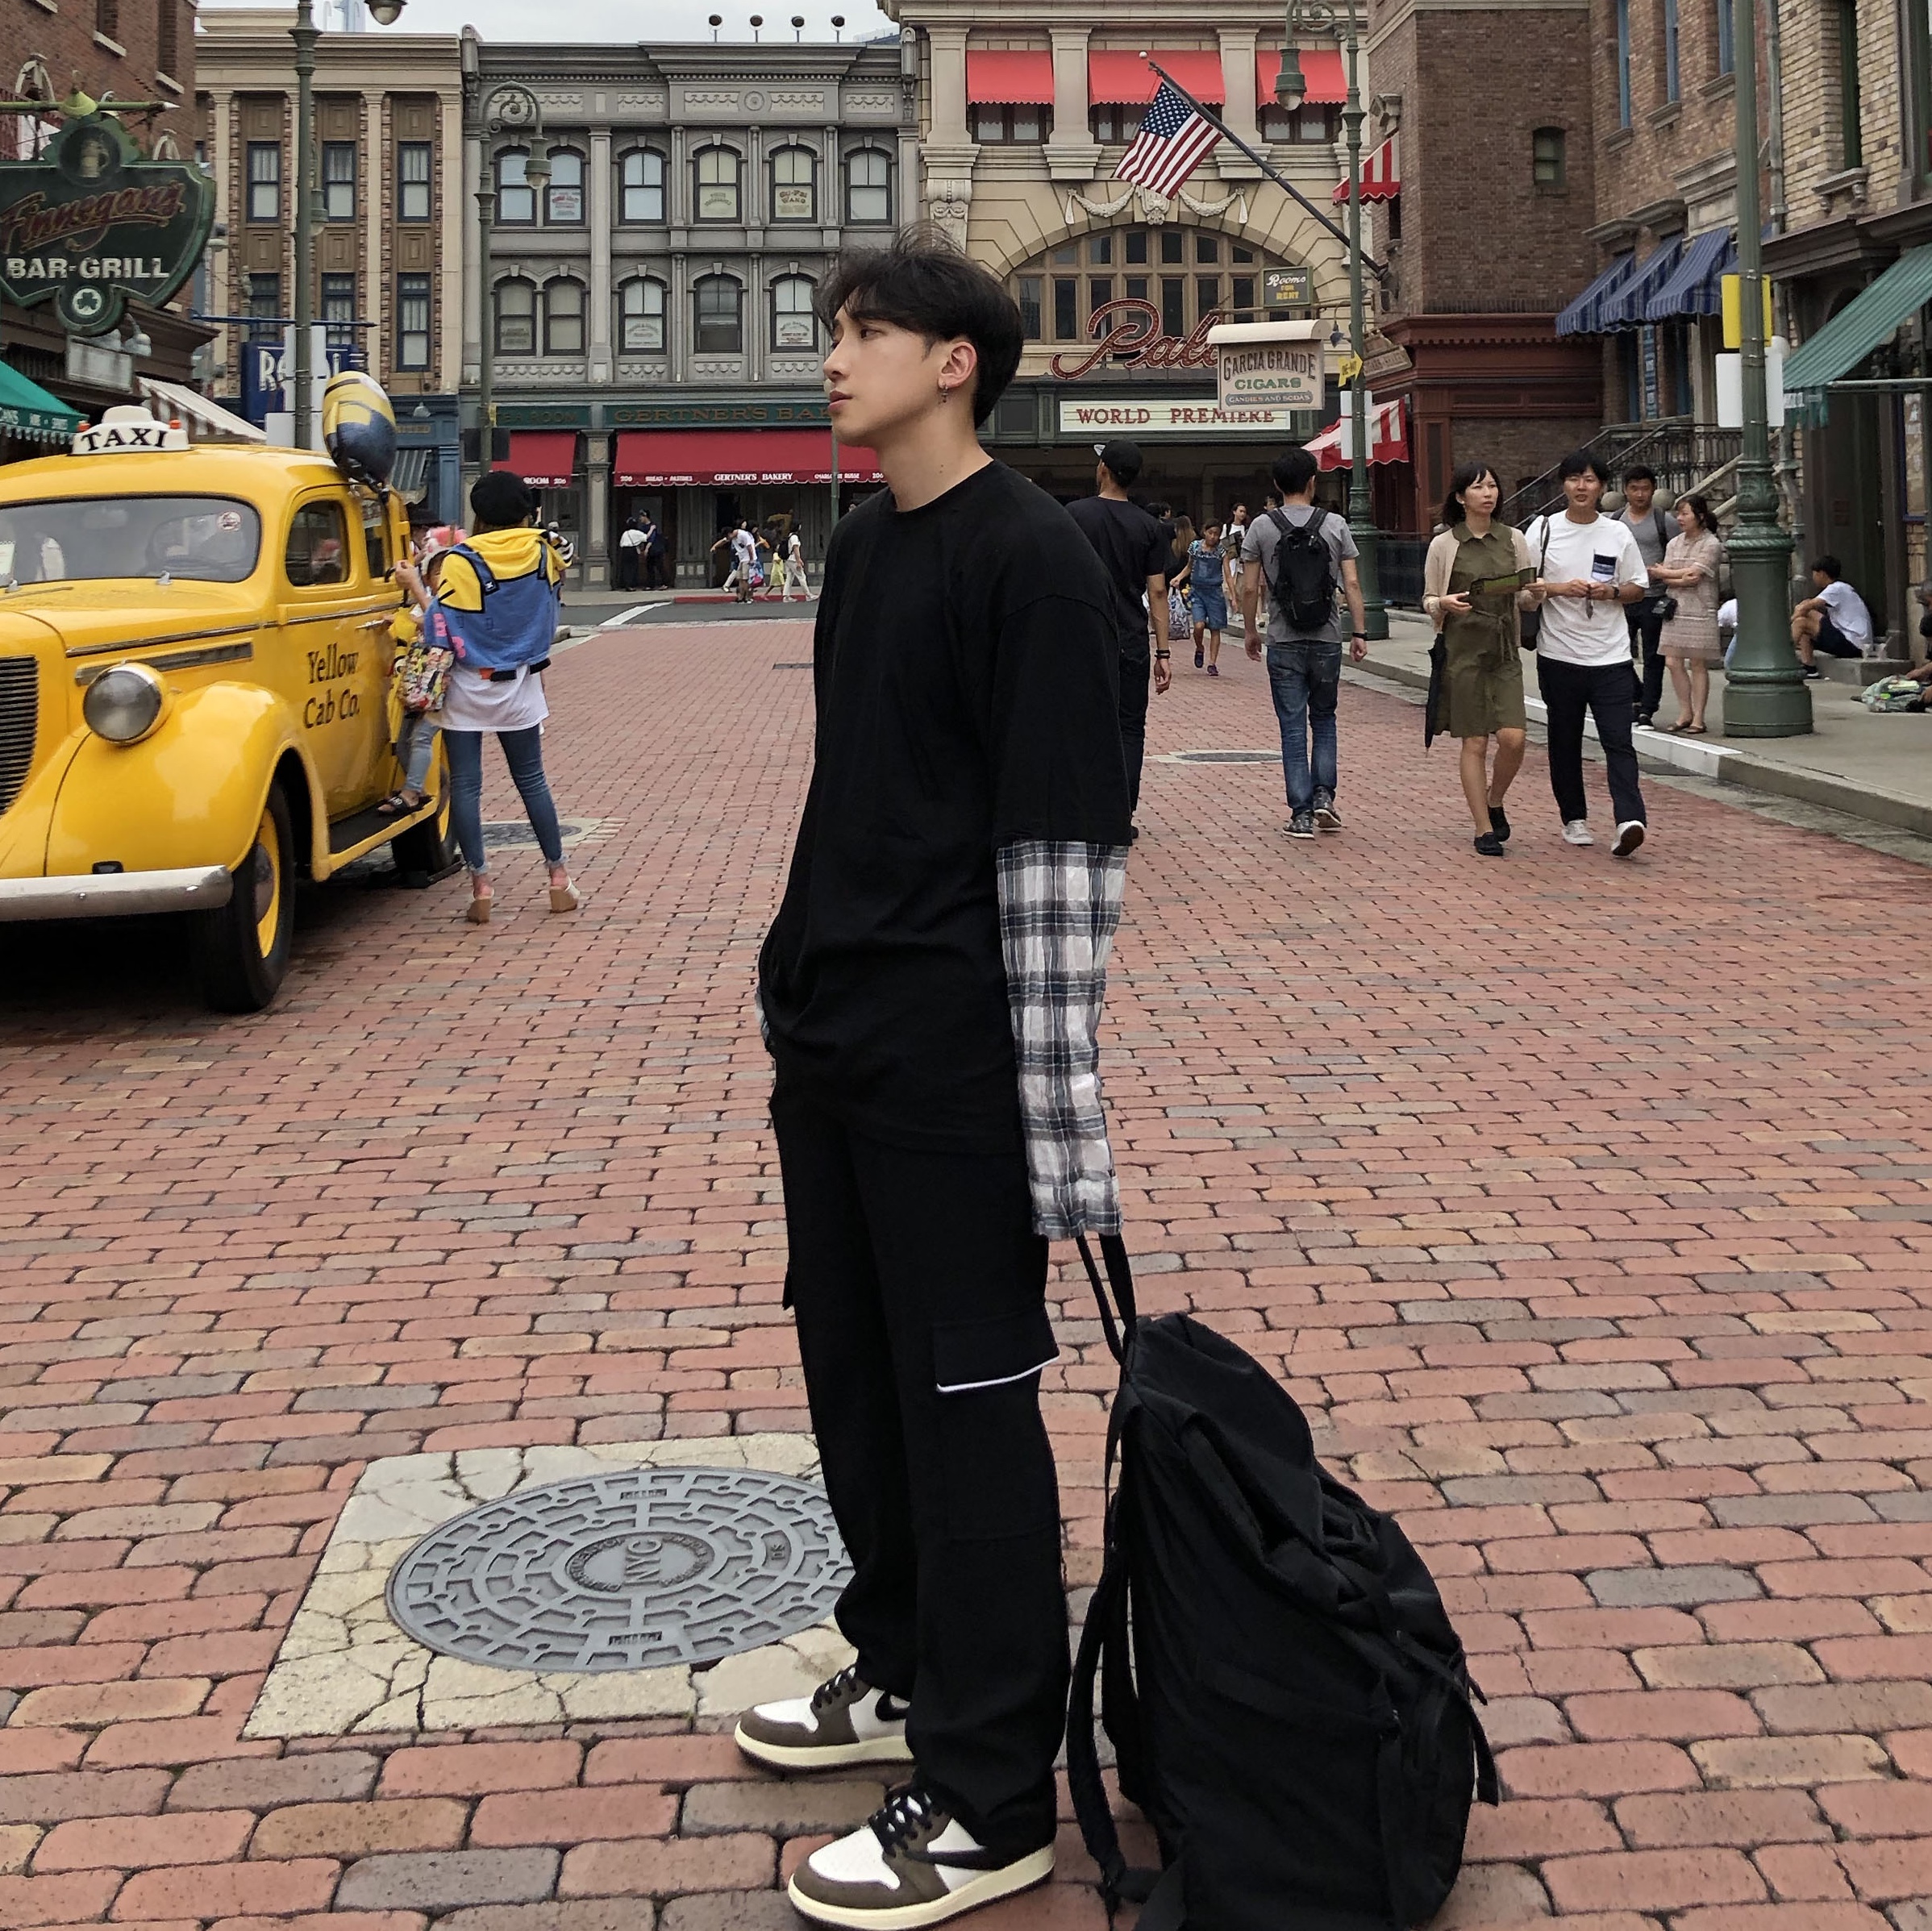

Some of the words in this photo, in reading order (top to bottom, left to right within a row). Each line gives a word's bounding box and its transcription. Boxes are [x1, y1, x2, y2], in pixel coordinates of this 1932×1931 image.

[1266, 273, 1306, 287] Rooms
[1223, 352, 1265, 381] GARCIA
[1267, 350, 1316, 381] GRANDE
[1235, 377, 1302, 390] CIGARS
[614, 406, 767, 422] GERTNER'S
[1076, 408, 1151, 424] WORLD
[1170, 407, 1275, 424] PREMIERE
[81, 427, 168, 452] TAXI
[714, 472, 757, 481] GERTNER'S
[762, 472, 793, 481] BAKERY
[306, 642, 360, 684] Yellow
[303, 689, 335, 729] Cab
[624, 1537, 664, 1588] NYC
